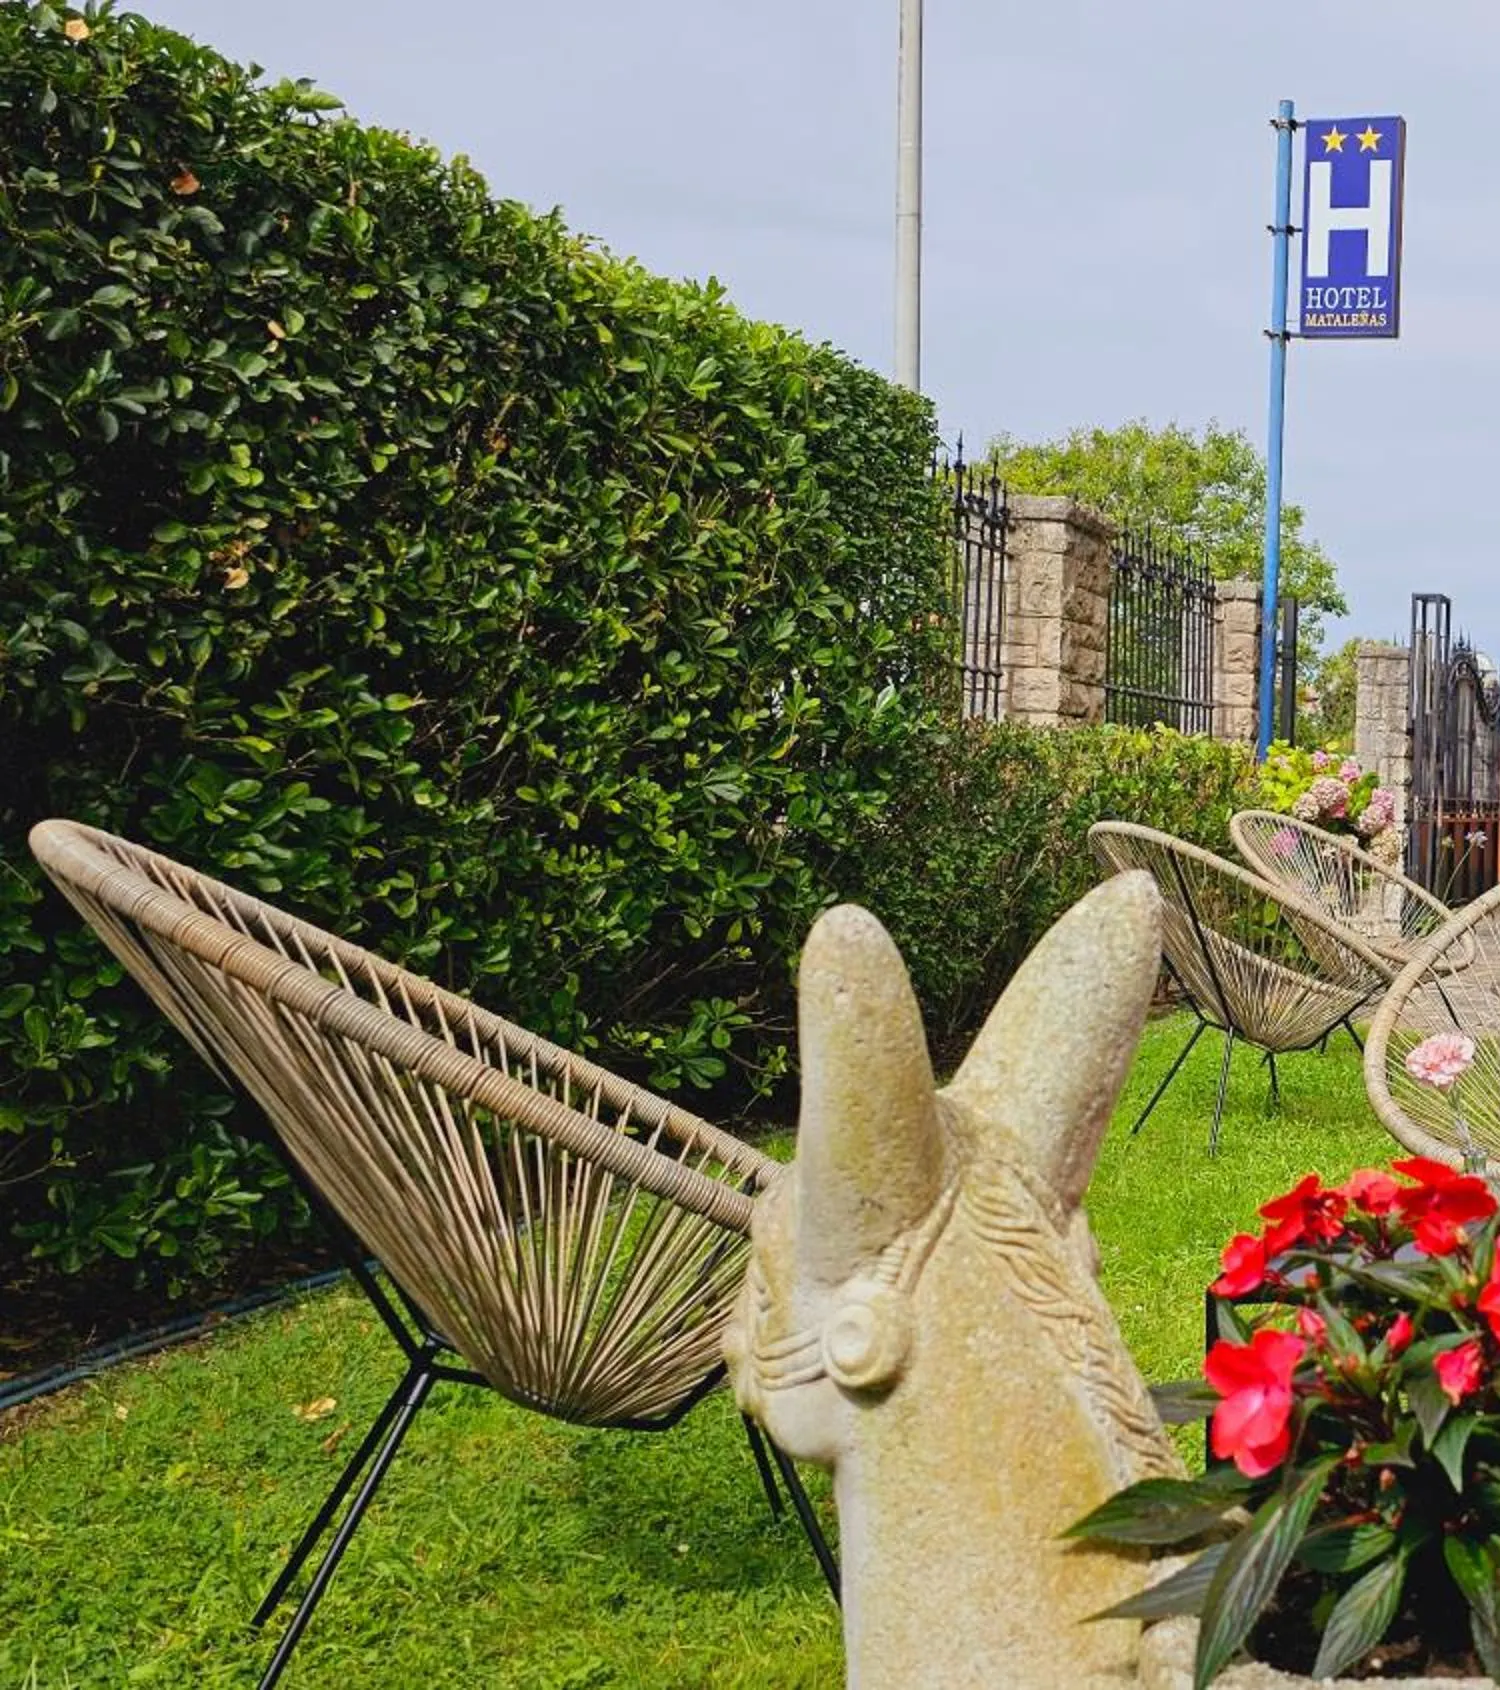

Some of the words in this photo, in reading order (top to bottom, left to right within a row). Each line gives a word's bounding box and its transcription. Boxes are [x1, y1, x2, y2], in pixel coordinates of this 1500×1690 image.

[1307, 160, 1392, 277] H
[1305, 287, 1387, 309] HOTEL
[1305, 311, 1387, 327] MATALEÑAS
